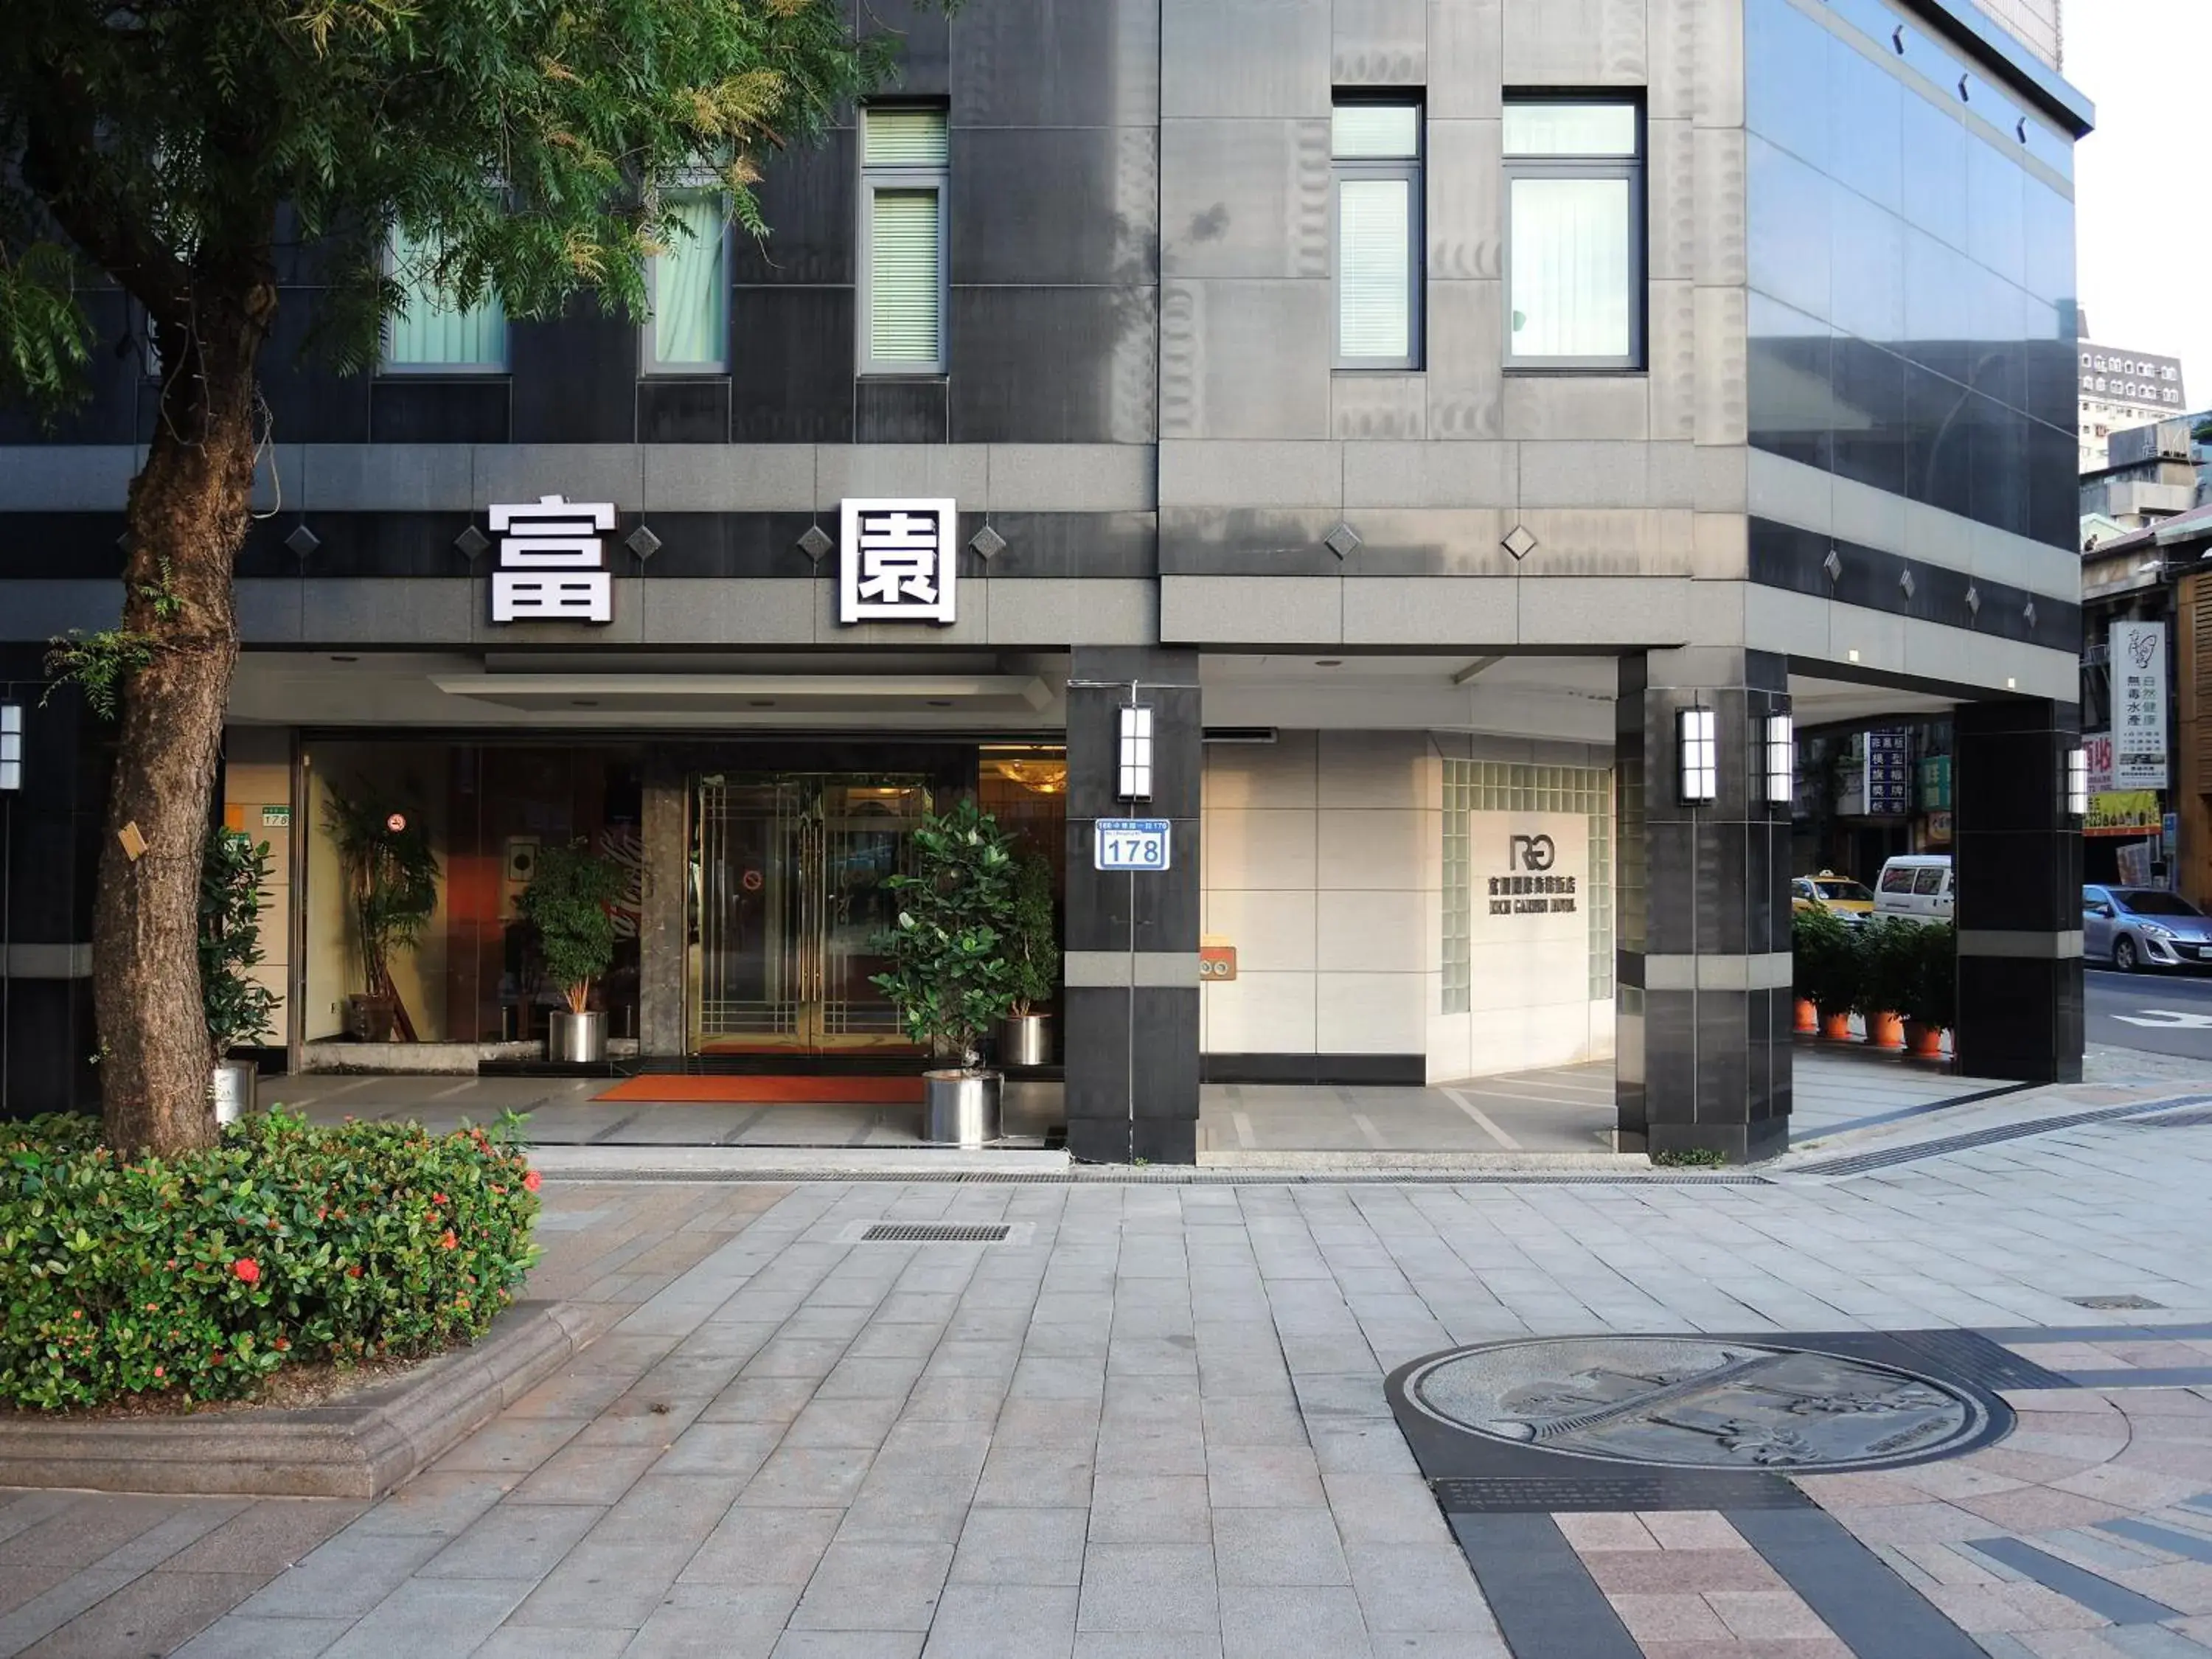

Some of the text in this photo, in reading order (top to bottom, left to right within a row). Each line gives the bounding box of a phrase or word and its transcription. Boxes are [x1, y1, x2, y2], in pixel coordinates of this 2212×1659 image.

[2127, 675, 2141, 726] 無毒水產
[1108, 839, 1158, 863] 178
